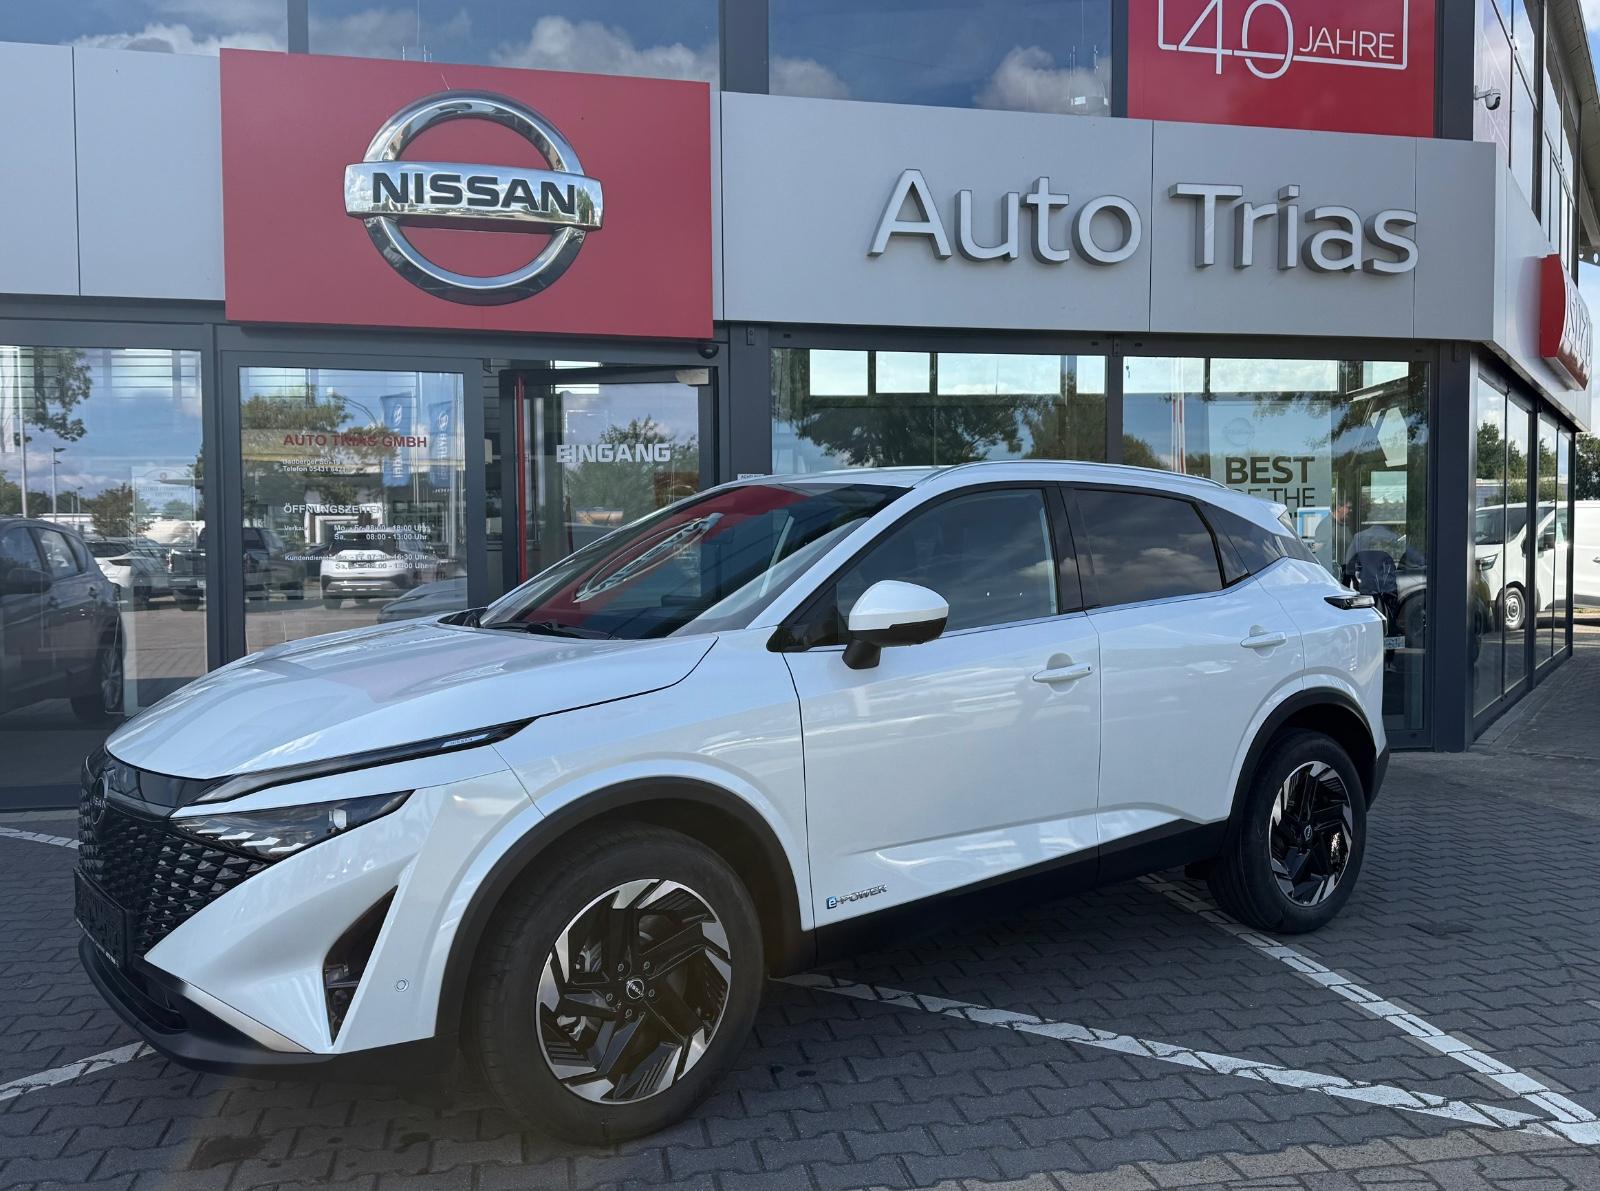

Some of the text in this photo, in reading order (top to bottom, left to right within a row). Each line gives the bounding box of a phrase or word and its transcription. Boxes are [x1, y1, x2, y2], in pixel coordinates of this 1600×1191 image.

[1178, 0, 1395, 79] 40 JAHRE
[372, 172, 576, 215] NISSAN
[867, 168, 1419, 274] Auto Trias
[283, 434, 427, 448] AUTO TRIAS GMBH
[556, 444, 671, 463] EINGANG
[1225, 456, 1316, 484] BEST
[1267, 488, 1316, 507] THE
[826, 884, 888, 909] e-POWER
